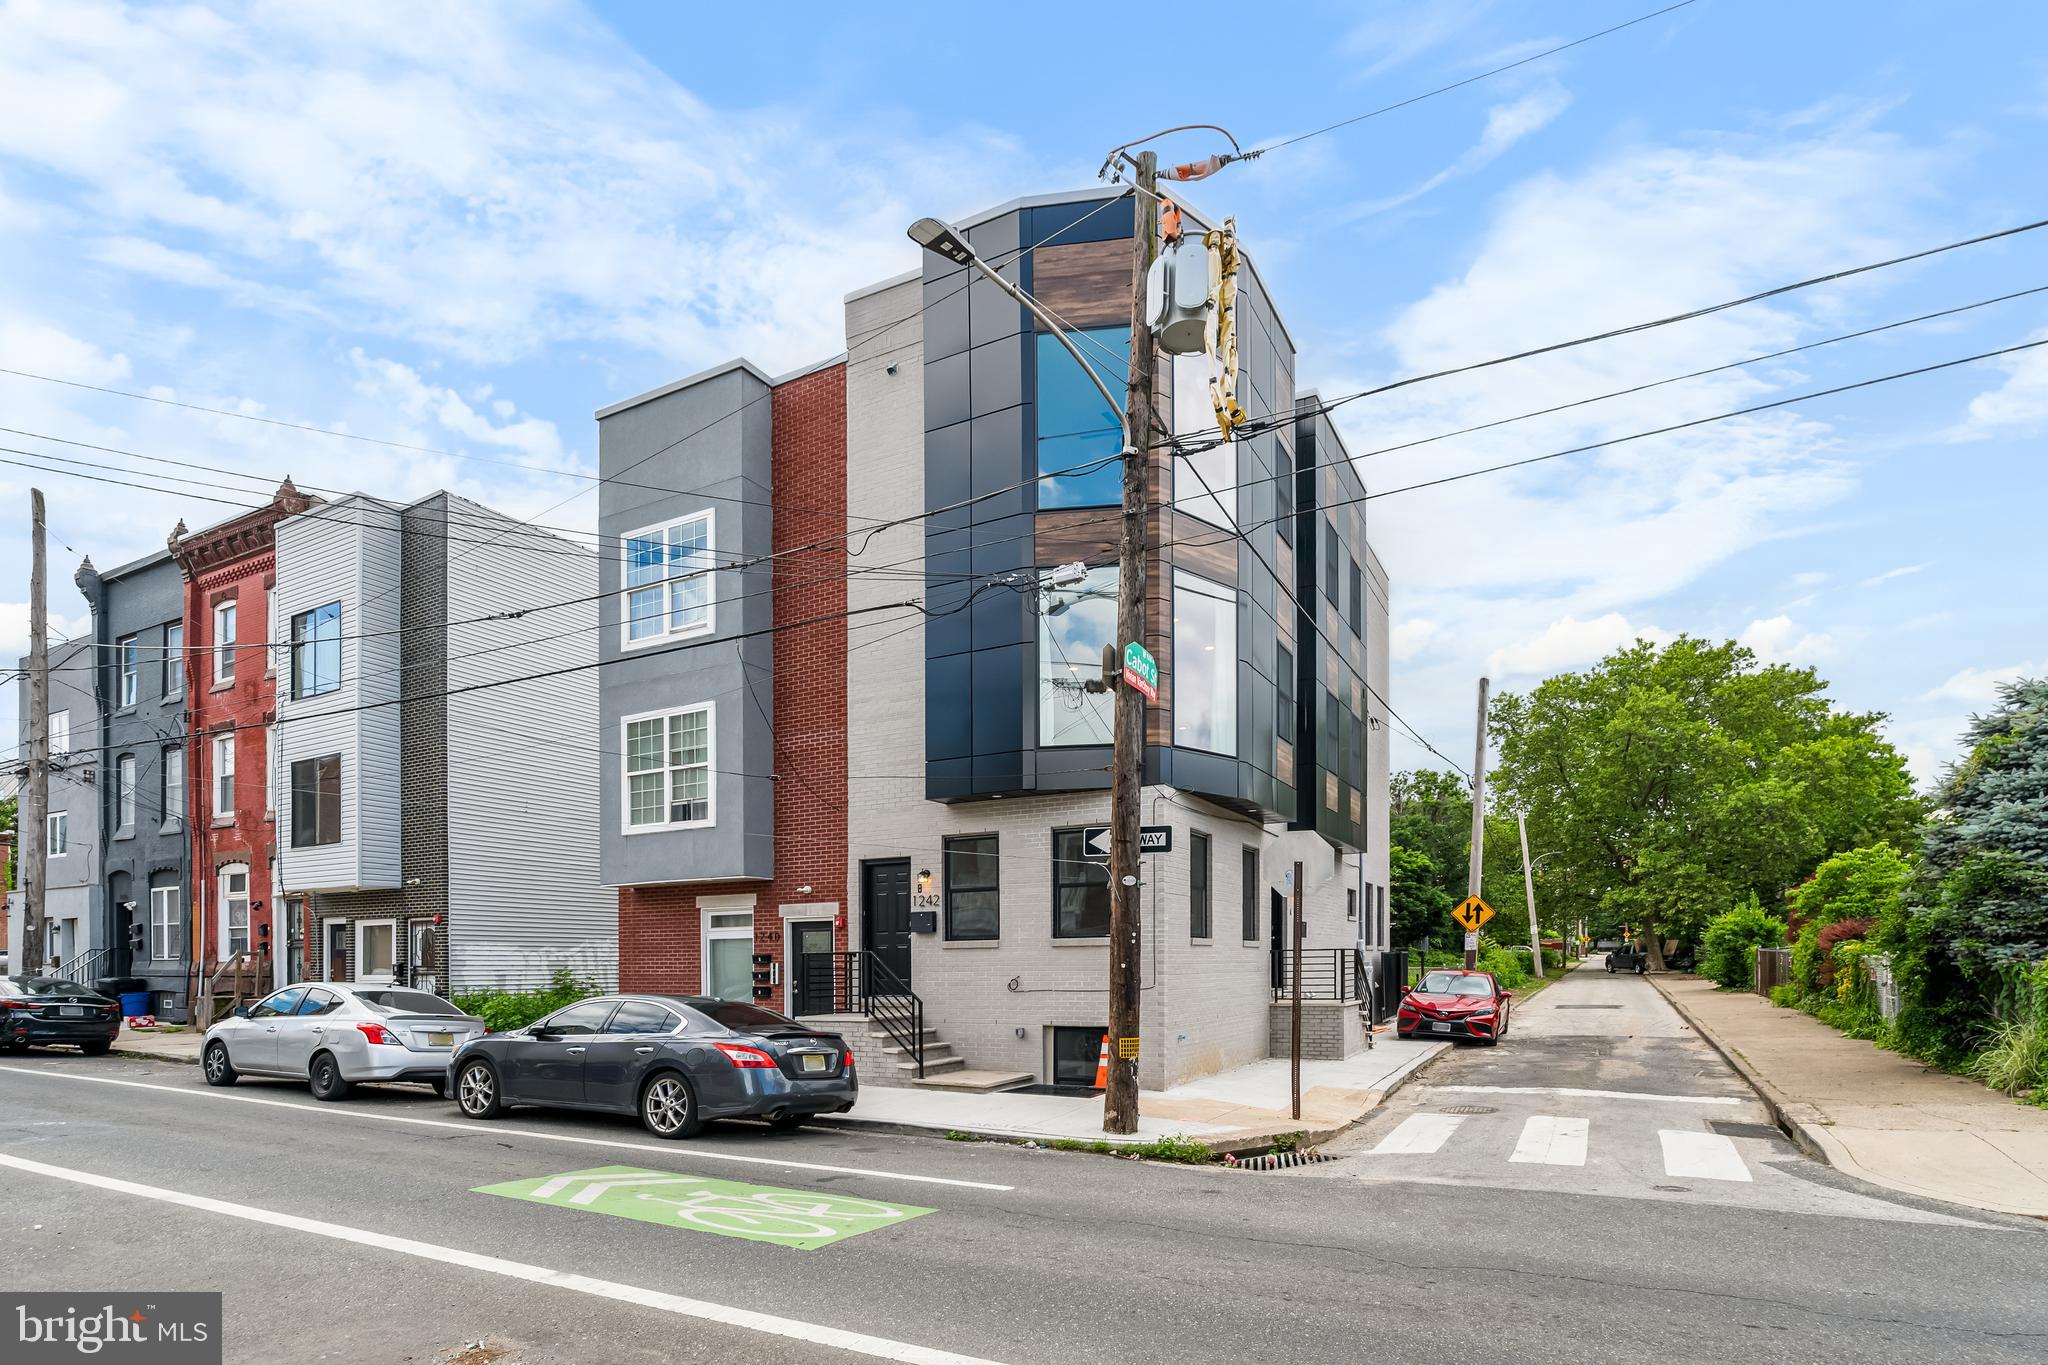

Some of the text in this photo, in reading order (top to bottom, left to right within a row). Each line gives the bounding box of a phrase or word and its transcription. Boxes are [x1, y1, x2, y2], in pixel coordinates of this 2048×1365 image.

[1126, 649, 1149, 678] Cabot
[1140, 834, 1163, 845] WAY
[913, 895, 940, 907] 1242
